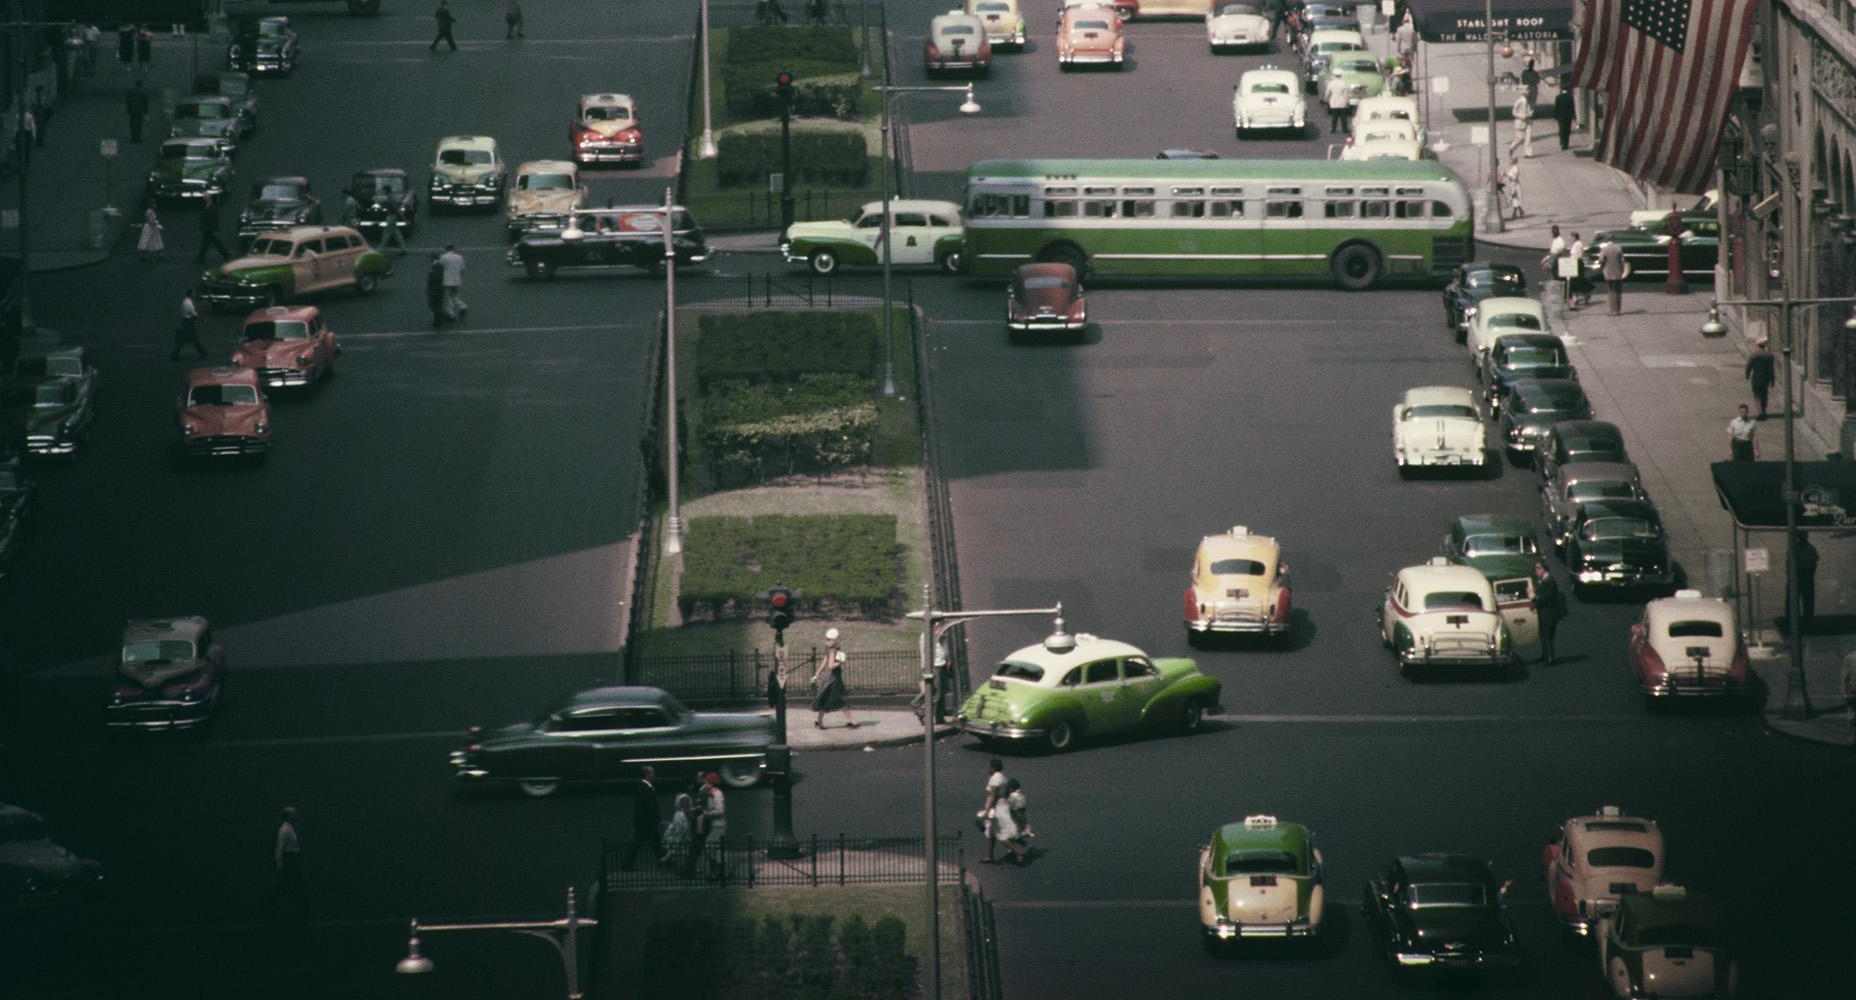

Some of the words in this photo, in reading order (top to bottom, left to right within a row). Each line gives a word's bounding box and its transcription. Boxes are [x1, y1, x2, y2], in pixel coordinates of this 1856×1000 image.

[1456, 18, 1509, 28] STARLGHT
[1516, 17, 1544, 26] ROOF
[1440, 33, 1456, 41] THE
